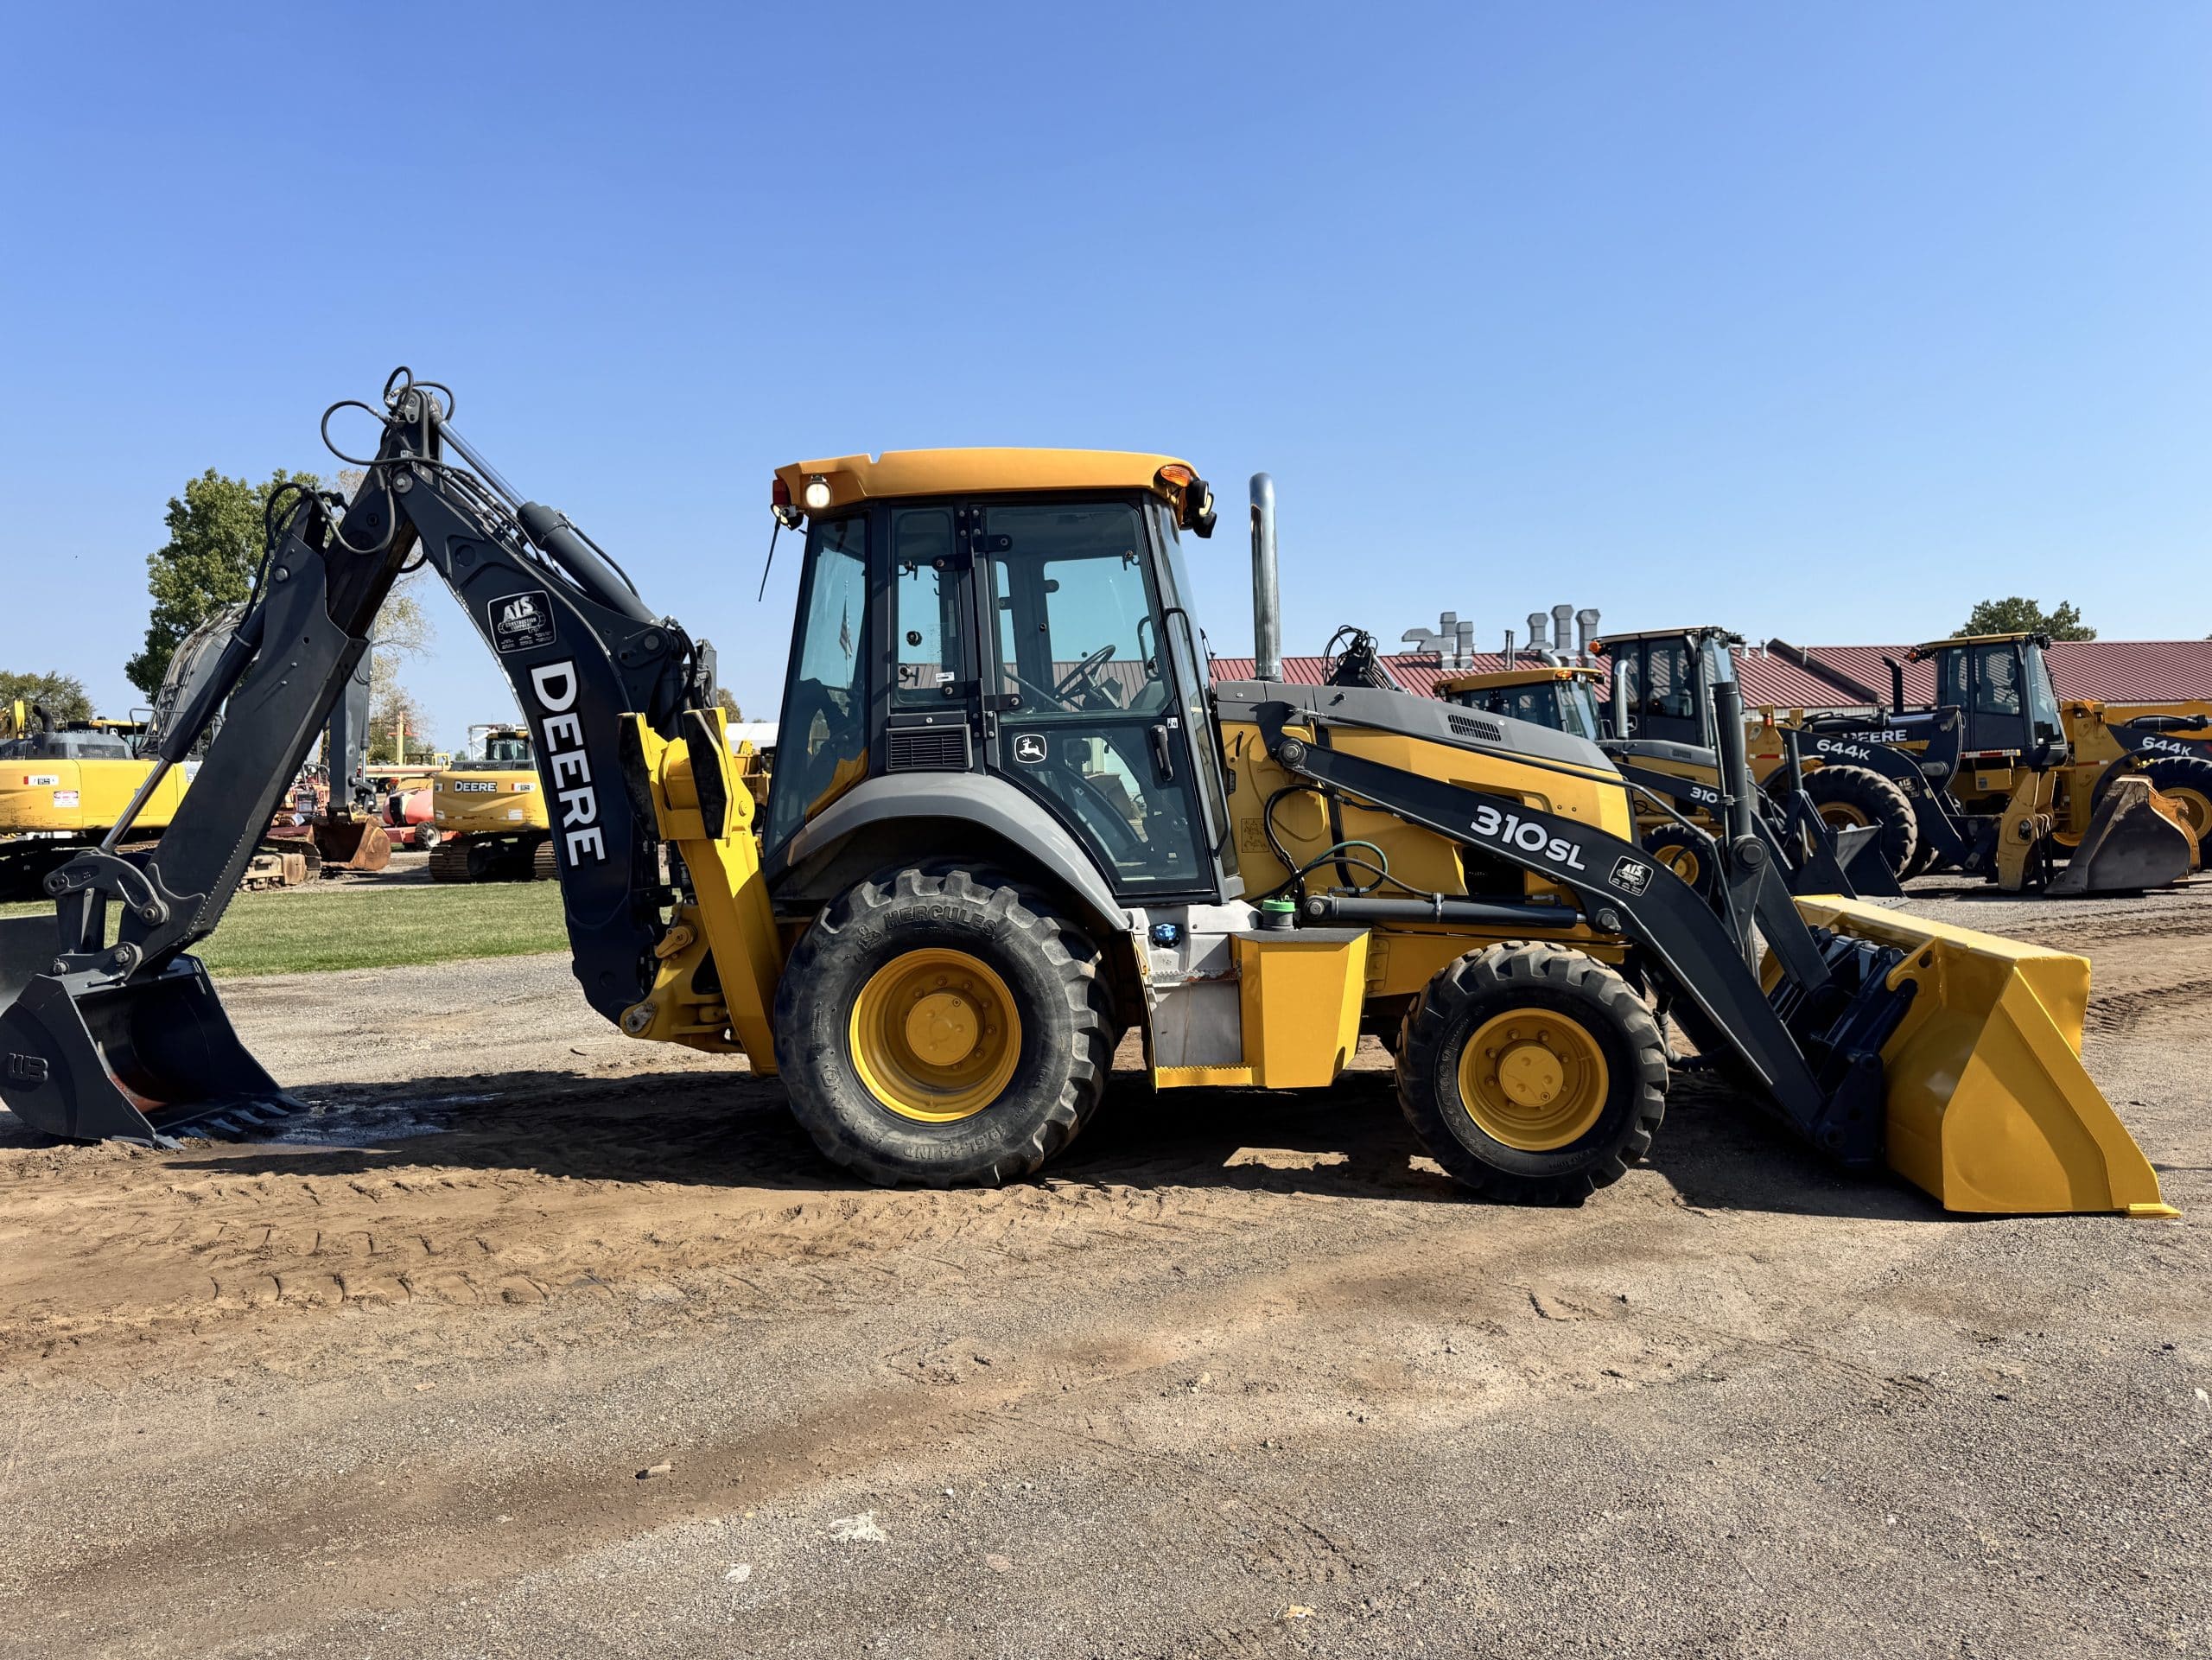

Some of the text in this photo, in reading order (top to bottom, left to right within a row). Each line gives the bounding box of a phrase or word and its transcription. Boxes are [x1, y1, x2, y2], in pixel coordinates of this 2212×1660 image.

[504, 596, 534, 622] AIS
[1816, 739, 1871, 760] 644K
[2142, 736, 2192, 756] 644K
[531, 660, 606, 867] DEERE
[454, 780, 497, 792] DEERE
[1470, 805, 1586, 871] 310SL
[1622, 863, 1646, 877] AIS
[883, 904, 997, 936] HERCULES
